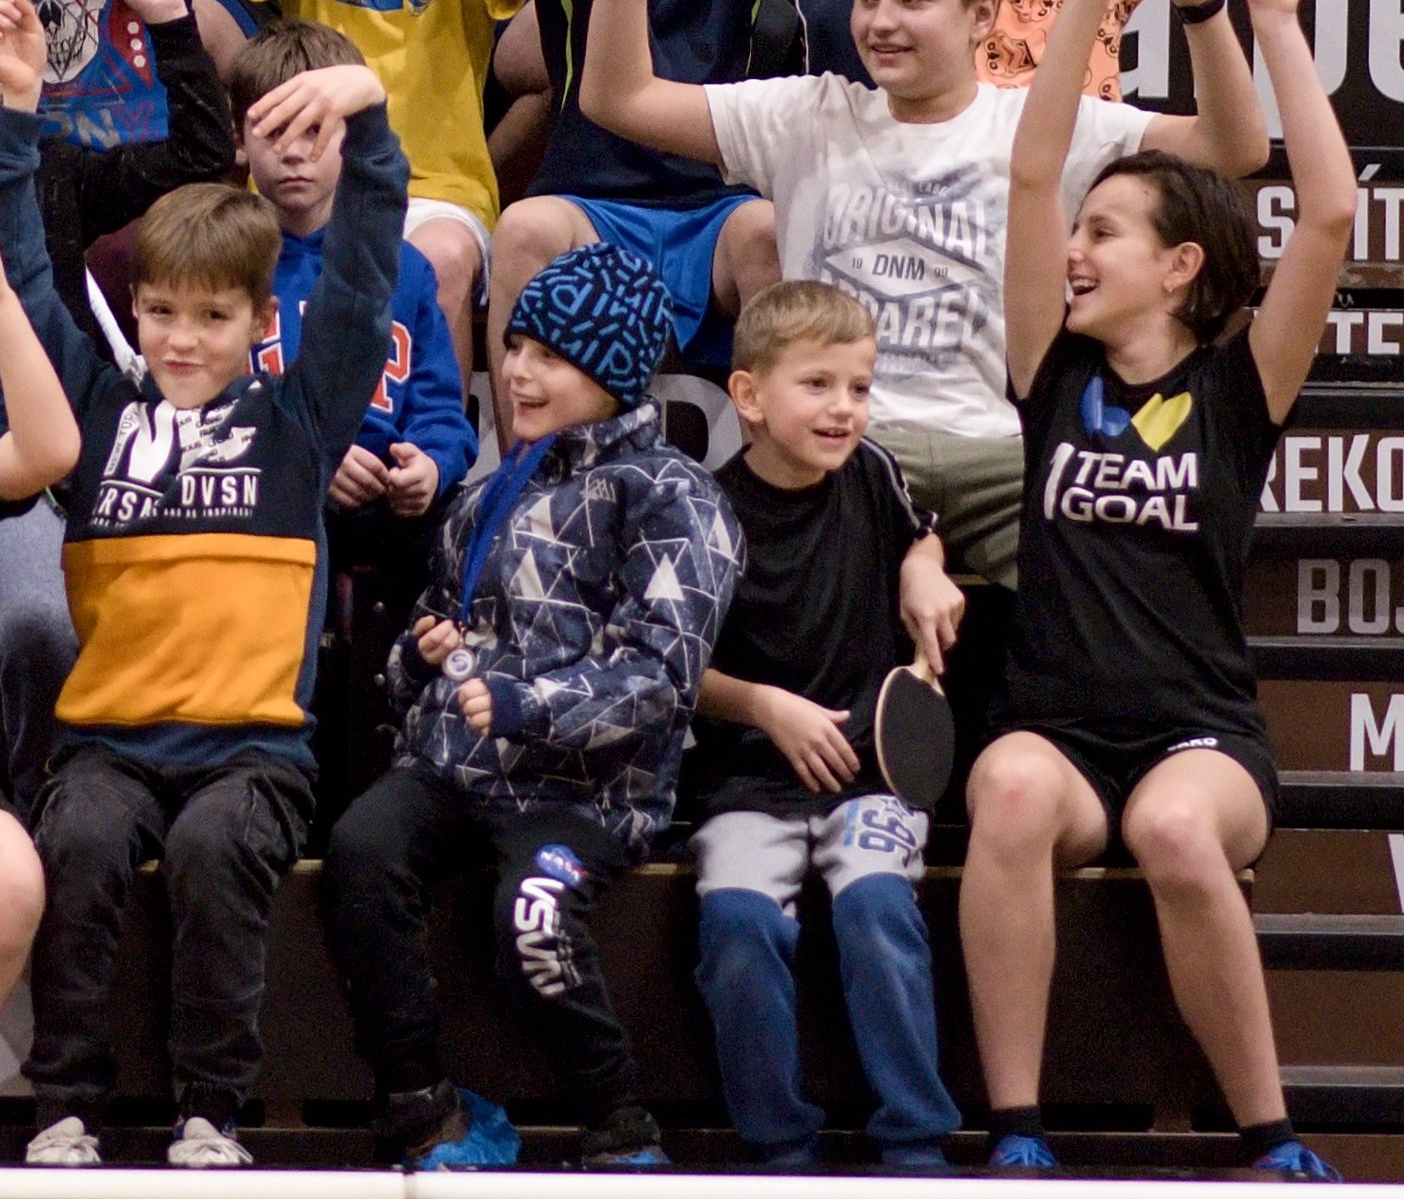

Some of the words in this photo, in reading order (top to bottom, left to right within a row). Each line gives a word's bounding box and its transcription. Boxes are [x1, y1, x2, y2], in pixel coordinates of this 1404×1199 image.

[823, 184, 990, 263] ORIGINAL
[1257, 163, 1404, 262] SÍT
[872, 253, 926, 281] DNM
[820, 269, 983, 347] PAREL
[181, 474, 257, 507] DVSN
[1060, 486, 1199, 531] GOAL
[1074, 450, 1198, 492] TEAM
[1297, 557, 1404, 635] BO
[513, 877, 567, 996] NASA
